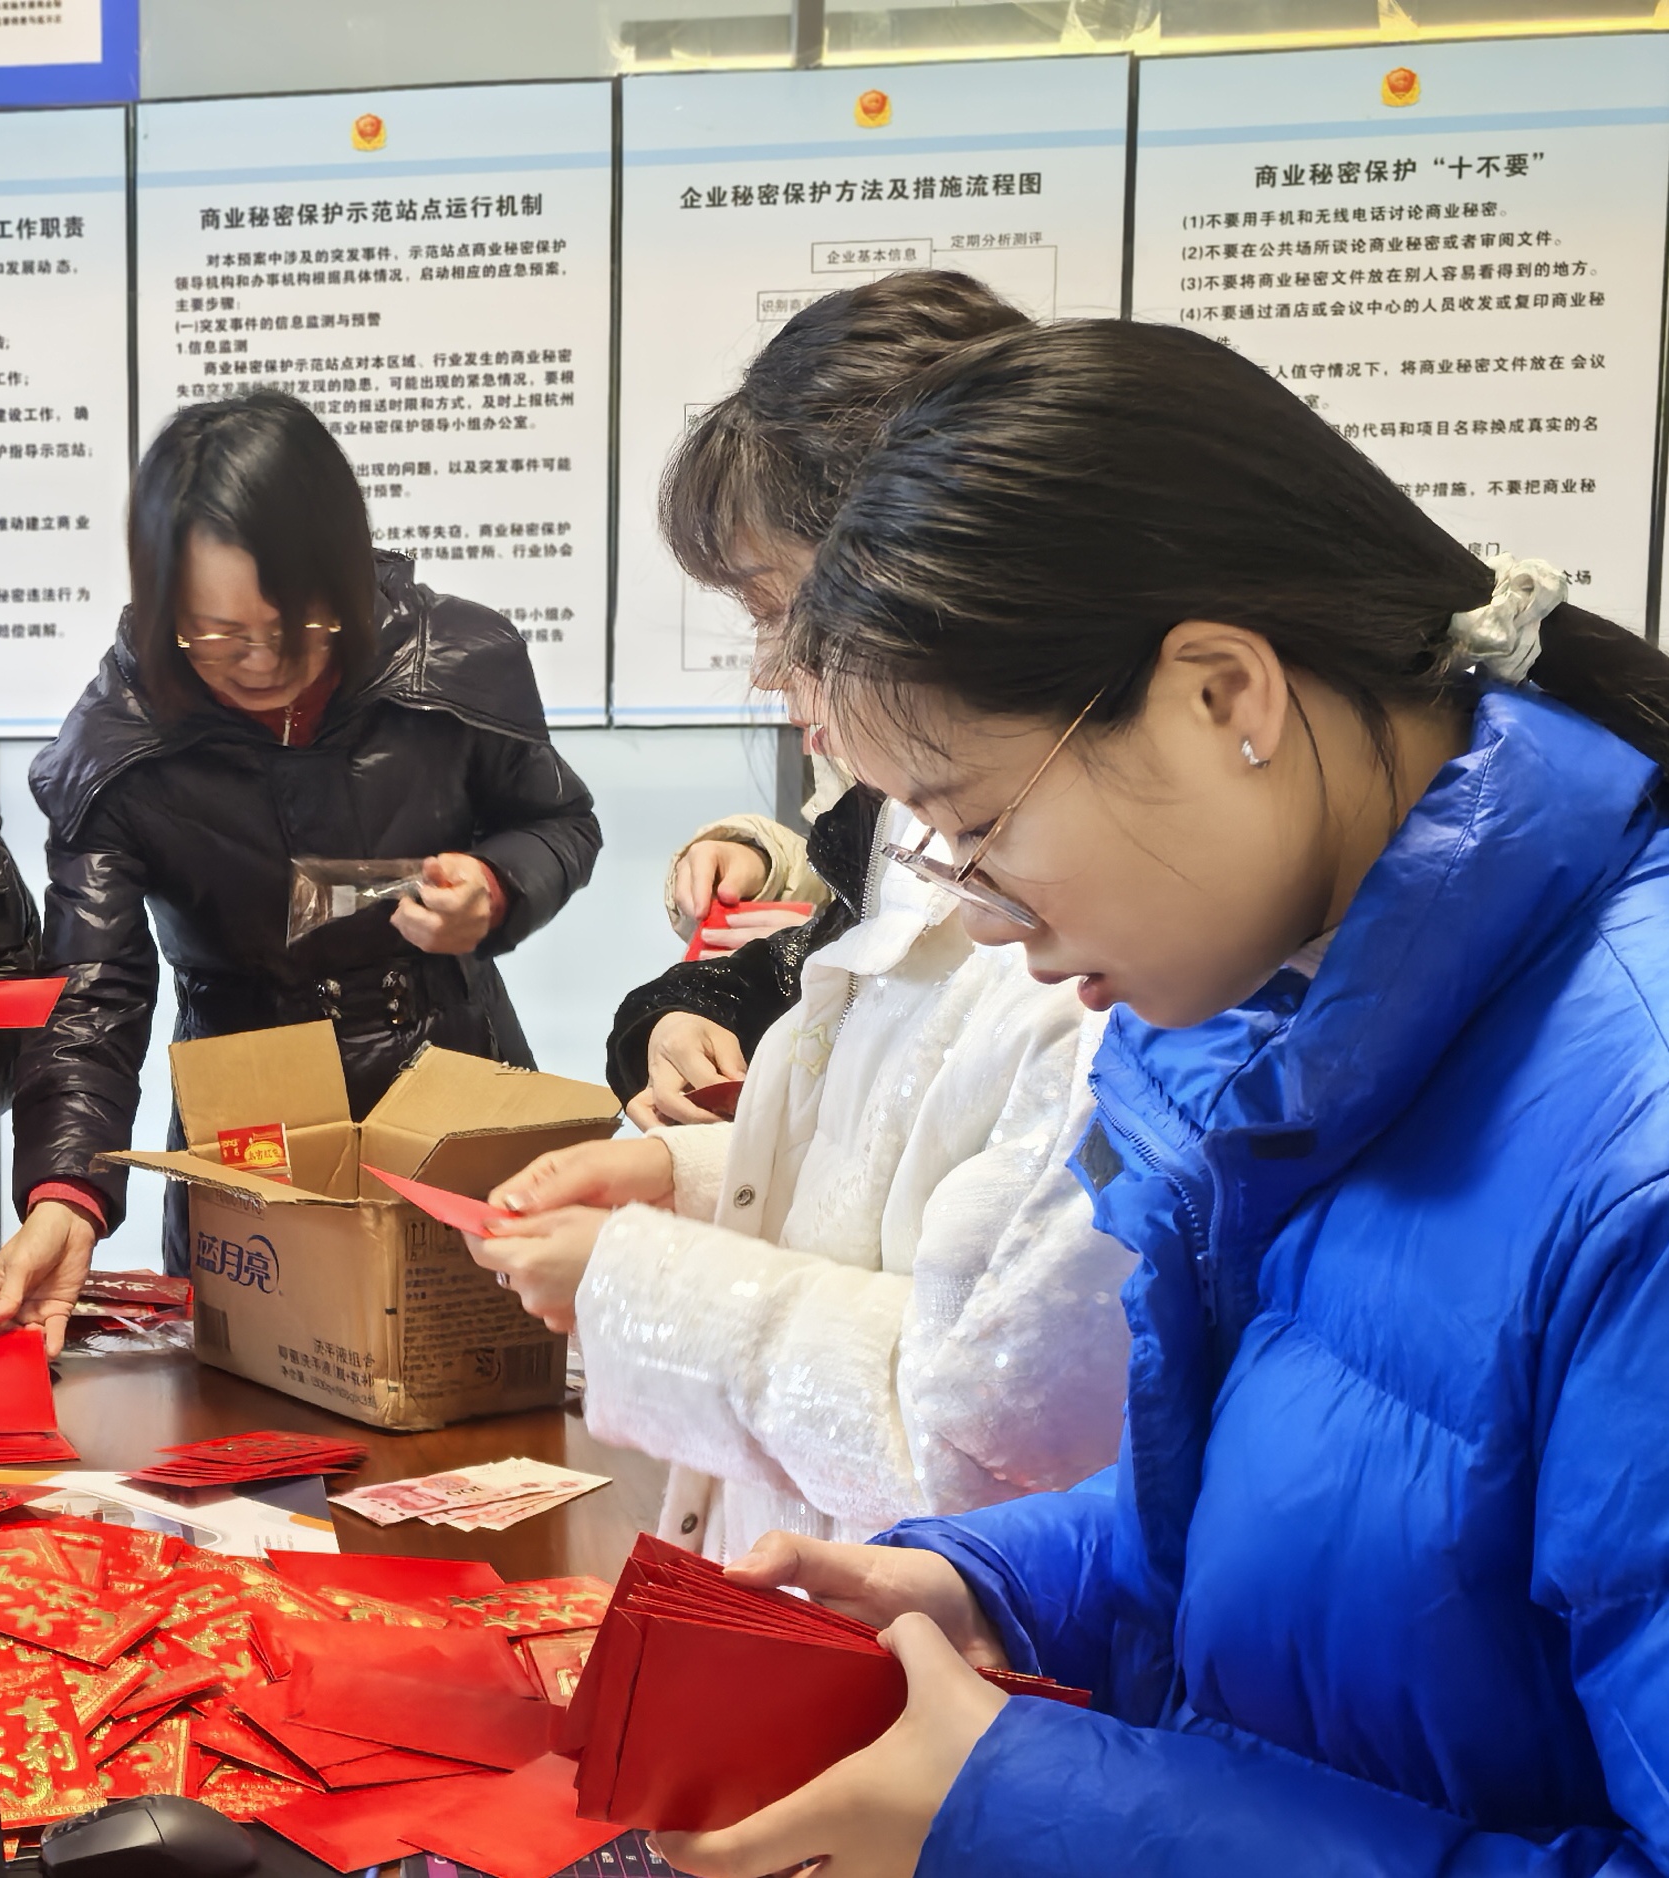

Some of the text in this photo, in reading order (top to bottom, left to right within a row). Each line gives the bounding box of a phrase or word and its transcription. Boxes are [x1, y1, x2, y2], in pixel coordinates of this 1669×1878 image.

[1255, 151, 1545, 189] 商业秘密保护“十不要”
[679, 171, 1043, 210] 企业秘密保护方法及措施流程图
[199, 192, 543, 231] 商业秘密保护示范站点运行机制
[1182, 201, 1507, 231] (1)不要用手机和无线电话讨论商业秘密。
[205, 238, 567, 268] 对本预案中涉及的突发事件，示范站点商业秘密保护
[950, 231, 1043, 249] 定期分析测评
[1181, 229, 1562, 262] (2)不要在公共场所谈论商业秘密或者审阅文件。
[826, 246, 918, 266] 企业基本信息
[1180, 259, 1598, 293] (3)不要将商业秘密文件放在别人容易看得到的地方。
[175, 295, 241, 313] 主要步骤：
[1179, 290, 1606, 323] (4)不要通过酒店或会议中心的人员收发或复印商业秘
[176, 339, 248, 356] 1.信息监测
[203, 347, 573, 377] 商业秘密保护示范站点对本区域、行业发生的商业秘密
[1258, 353, 1606, 380] 人值守情况下，将商业秘密文件放在会议
[350, 456, 572, 477] 出现的问题，以及突发事件可能
[196, 1231, 280, 1294] 蓝月亮
